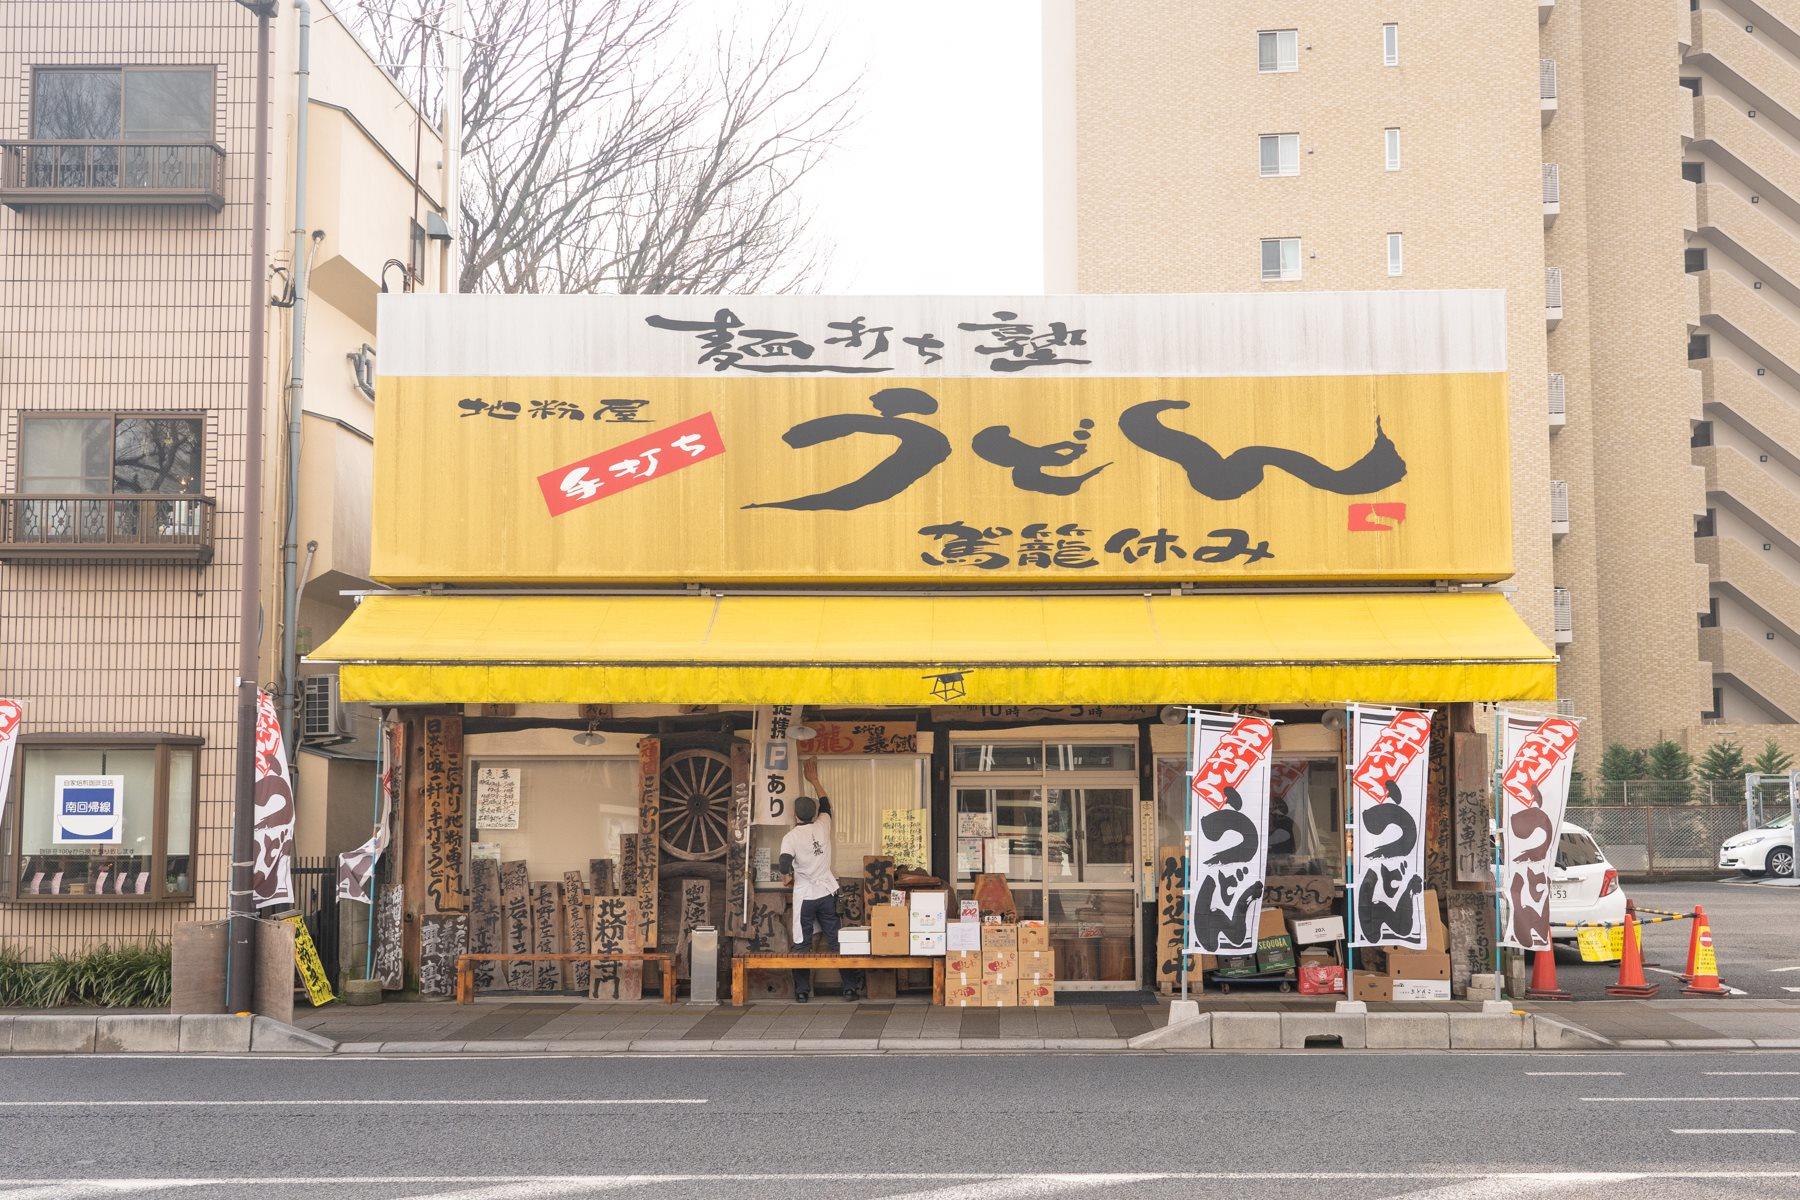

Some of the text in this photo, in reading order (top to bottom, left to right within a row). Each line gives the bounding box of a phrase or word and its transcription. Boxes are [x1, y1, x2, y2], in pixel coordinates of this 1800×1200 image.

[458, 398, 656, 423] 地粉屋
[740, 387, 1407, 512] うどん
[560, 432, 707, 500] 手打ち
[917, 521, 1276, 570] 駕籠休み
[1195, 723, 1270, 803] 手打ち
[1357, 717, 1428, 797] 手打ち
[1505, 723, 1574, 801] 手打ち
[65, 801, 111, 813] 南回帰線
[1193, 786, 1264, 952] うどん
[1357, 780, 1423, 944] うどん
[1258, 937, 1288, 949] SEQUOIA
